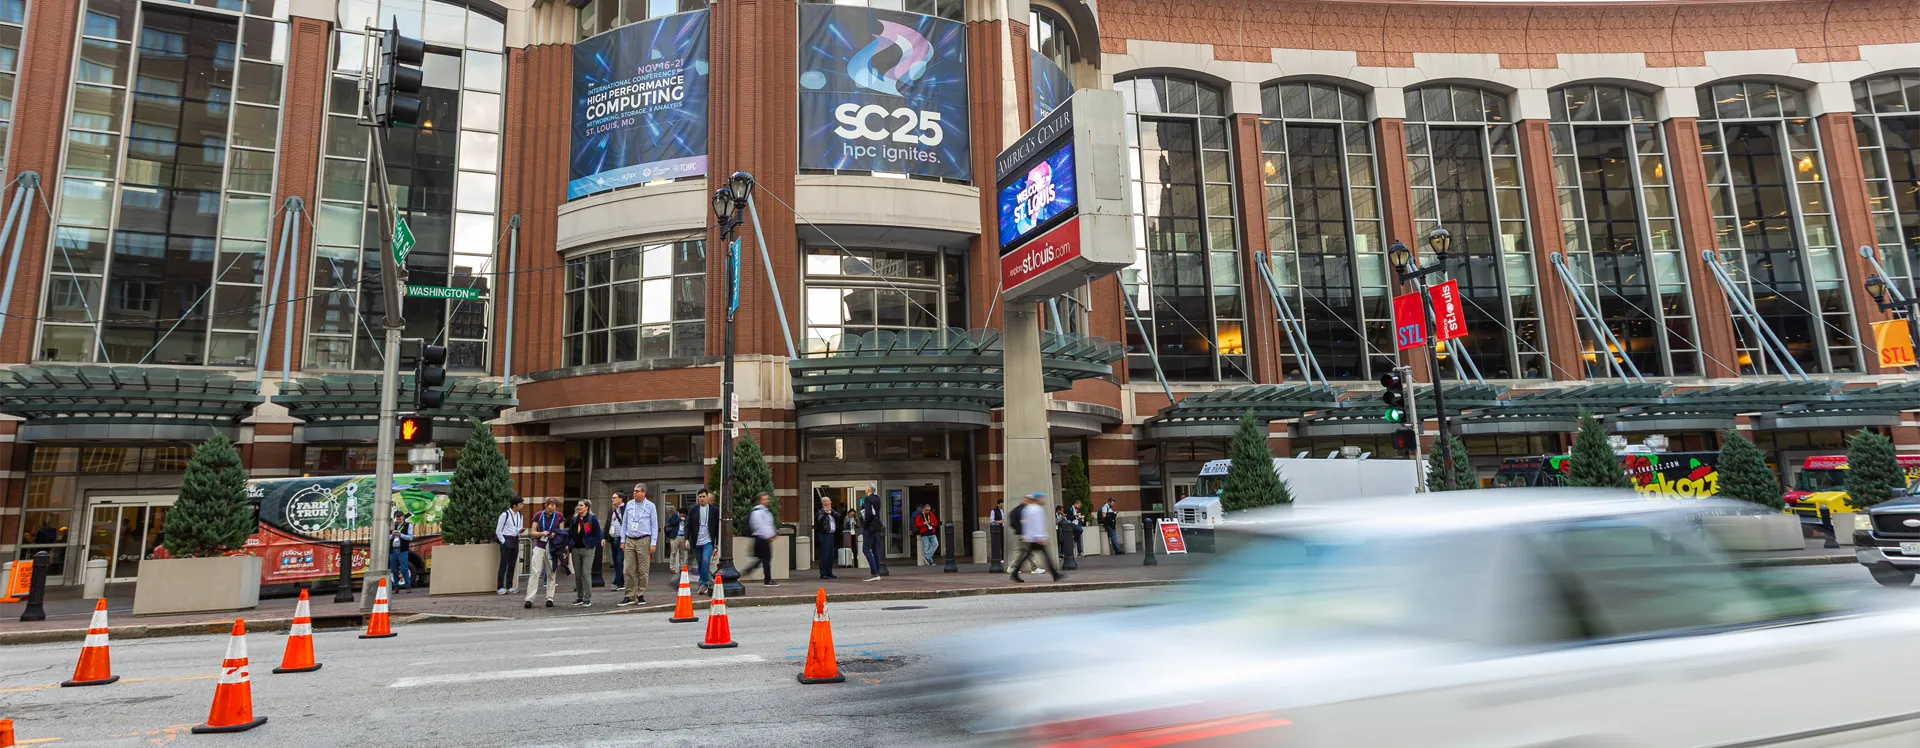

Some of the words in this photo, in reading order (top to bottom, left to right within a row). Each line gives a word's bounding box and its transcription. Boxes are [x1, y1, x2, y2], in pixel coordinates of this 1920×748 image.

[637, 64, 658, 75] NOV
[660, 58, 684, 70] 16-21
[587, 78, 631, 96] INTERNATIONAL
[632, 69, 676, 83] CONFERENCE
[587, 91, 607, 106] HIGH
[608, 75, 684, 99] PERFORMANCE
[586, 85, 684, 120] COMPUTING
[586, 115, 620, 128] NETWORKING,
[620, 107, 648, 119] STORAGE,
[653, 102, 683, 111] ANALYSIS
[834, 102, 943, 147] SC25
[585, 127, 596, 137] ST.
[596, 121, 620, 134] LOUIS,
[621, 117, 635, 127] MO
[843, 142, 877, 160] hpc
[882, 144, 941, 164] ignites.
[997, 136, 1036, 177] AMERICA'S
[1037, 111, 1071, 144] CENTER
[1014, 203, 1027, 224] ST.
[1028, 183, 1056, 216] LOUIS
[409, 286, 469, 299] WASHINGTON
[1399, 323, 1424, 346] STL
[1881, 346, 1912, 364] STL
[296, 501, 329, 510] FARM
[296, 508, 329, 517] TRUK
